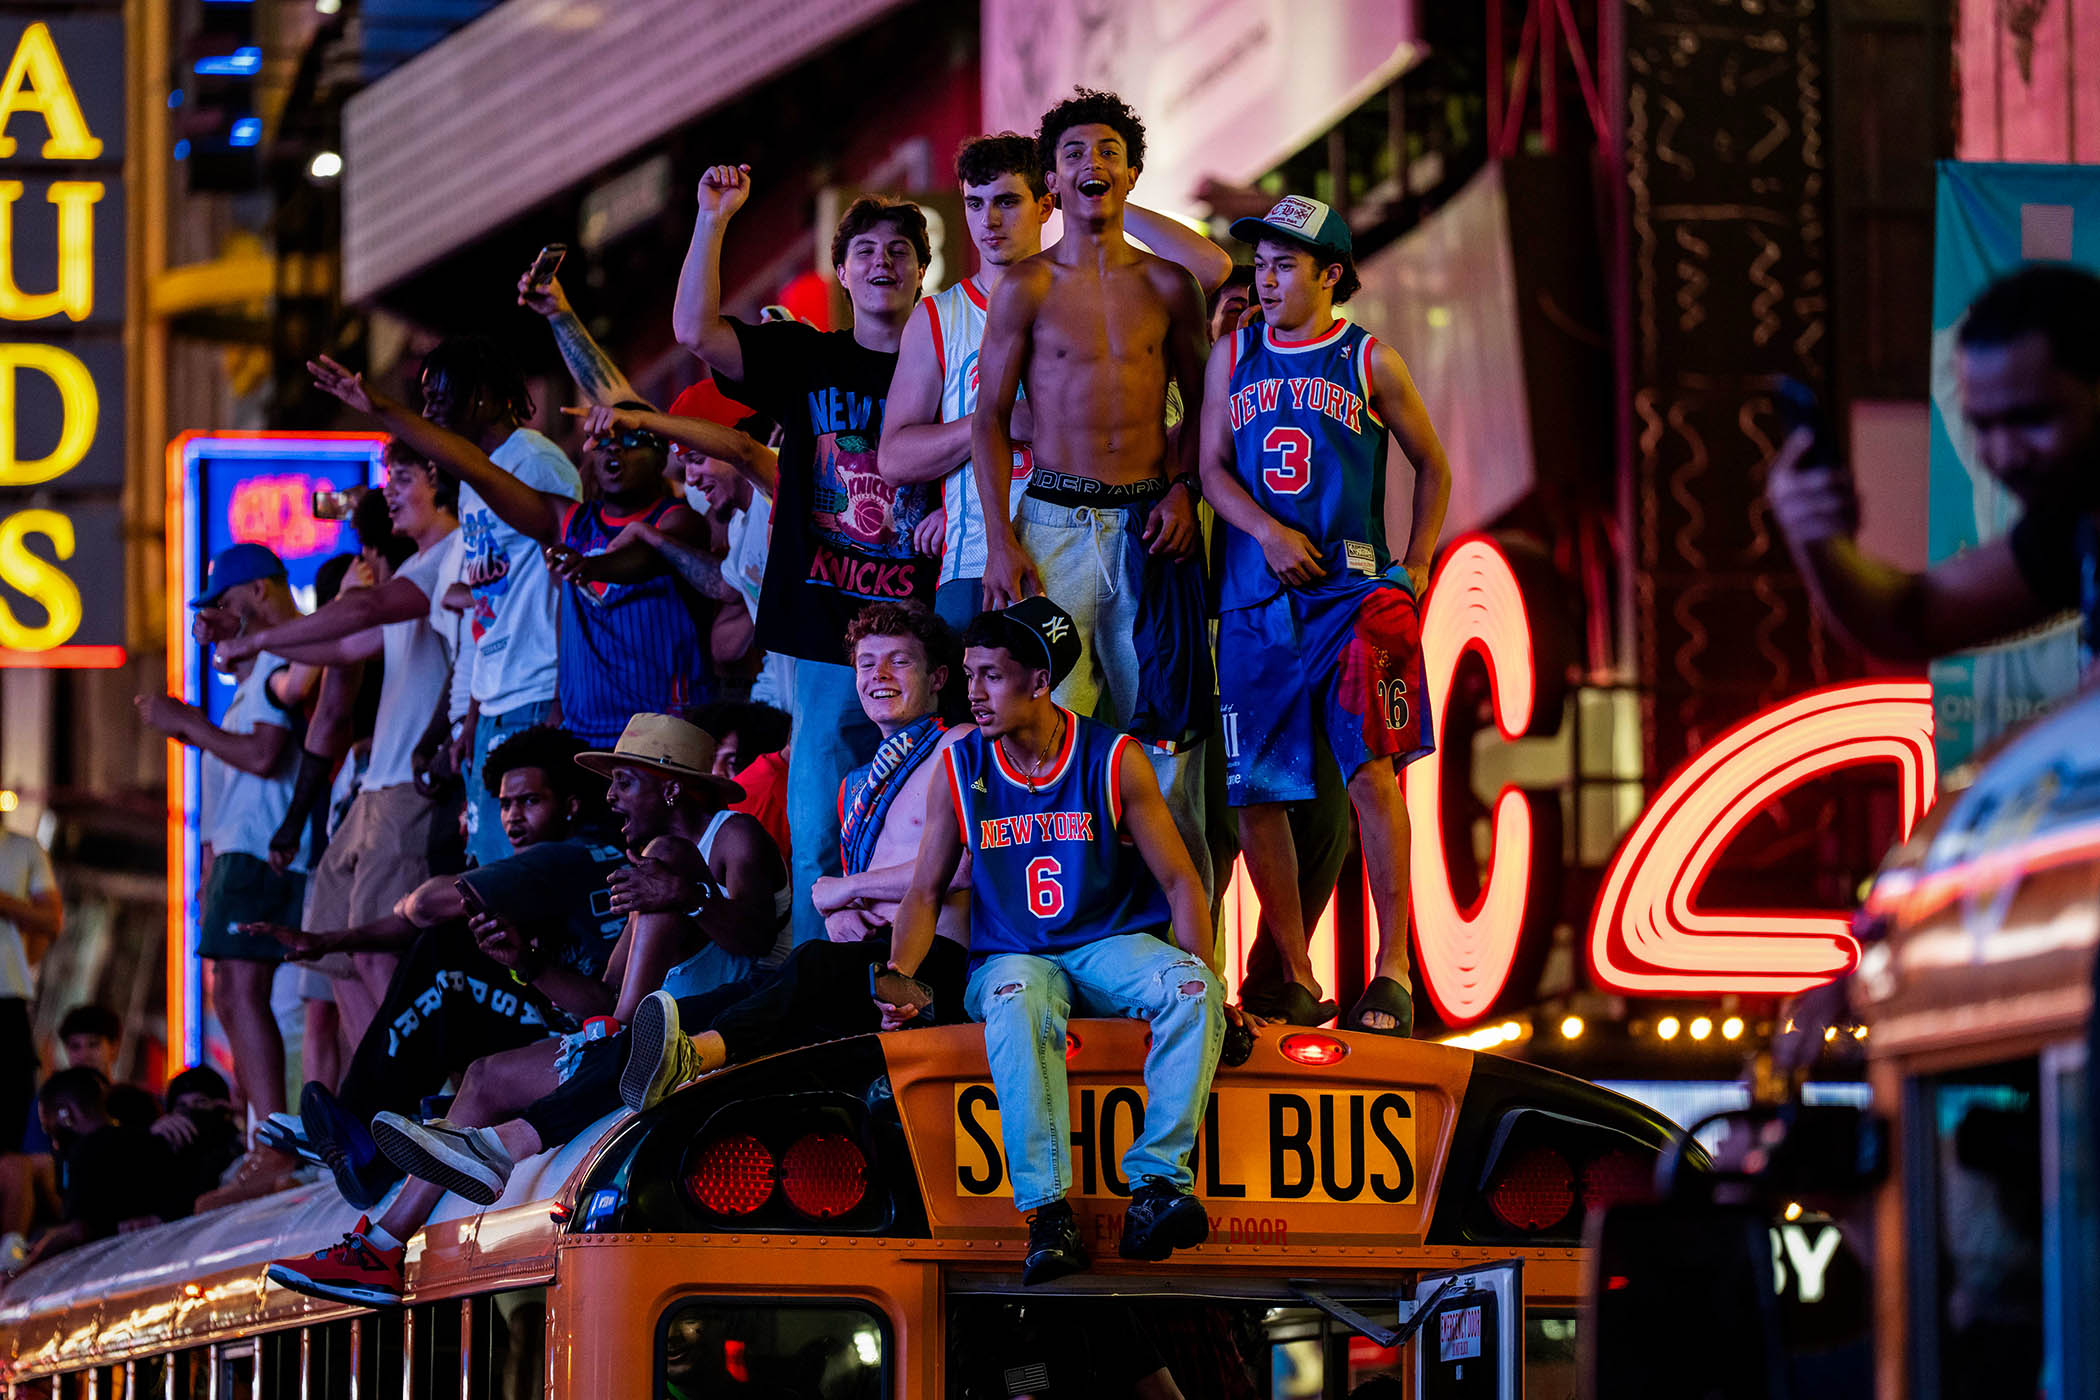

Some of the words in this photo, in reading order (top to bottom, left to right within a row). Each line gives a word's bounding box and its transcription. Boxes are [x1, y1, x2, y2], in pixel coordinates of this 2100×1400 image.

[808, 386, 872, 436] NEW
[1230, 379, 1284, 431] NEW
[1287, 377, 1363, 435] YORK
[1263, 426, 1312, 494] 3
[810, 546, 916, 597] KNICKS
[980, 815, 1033, 849] NEW
[1034, 811, 1094, 841] YORK
[1026, 855, 1064, 919] 6
[957, 1084, 1246, 1198] SHOL
[1269, 1092, 1415, 1203] BUS
[1230, 1217, 1287, 1245] DOOR
